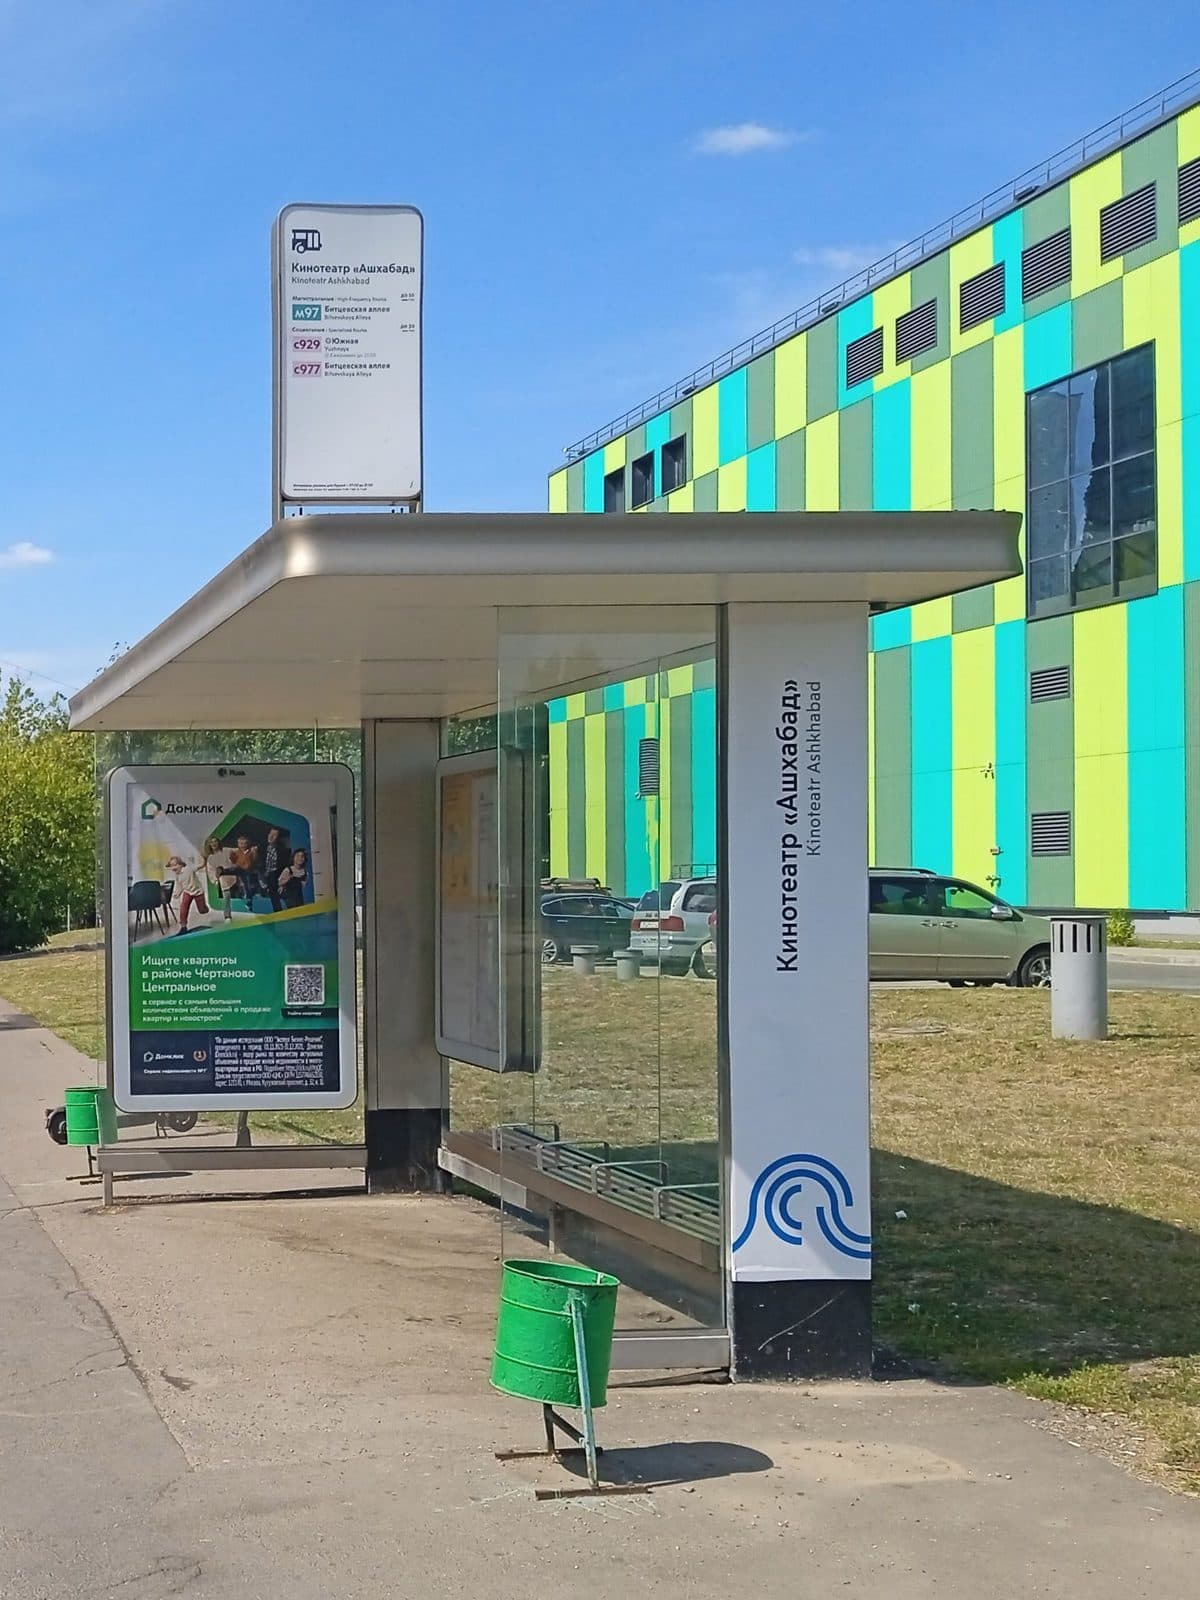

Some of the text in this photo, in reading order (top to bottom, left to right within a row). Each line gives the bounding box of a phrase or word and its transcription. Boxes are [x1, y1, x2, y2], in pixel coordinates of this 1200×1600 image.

[291, 262, 415, 275] Кинотеатр «Ашхабад»
[291, 276, 370, 285] Kinoteatr Ashkhabad
[324, 305, 367, 314] Битцевская
[324, 362, 367, 371] Битцевская
[806, 681, 821, 856] Kinoteatr Ashkhabad
[165, 803, 224, 815] Домклик
[776, 679, 802, 972] Кинотеатр «Ашхабад»
[142, 955, 237, 967] Ищите квартиры
[142, 967, 256, 981] в районе Чертаново
[142, 981, 217, 994] Центральное
